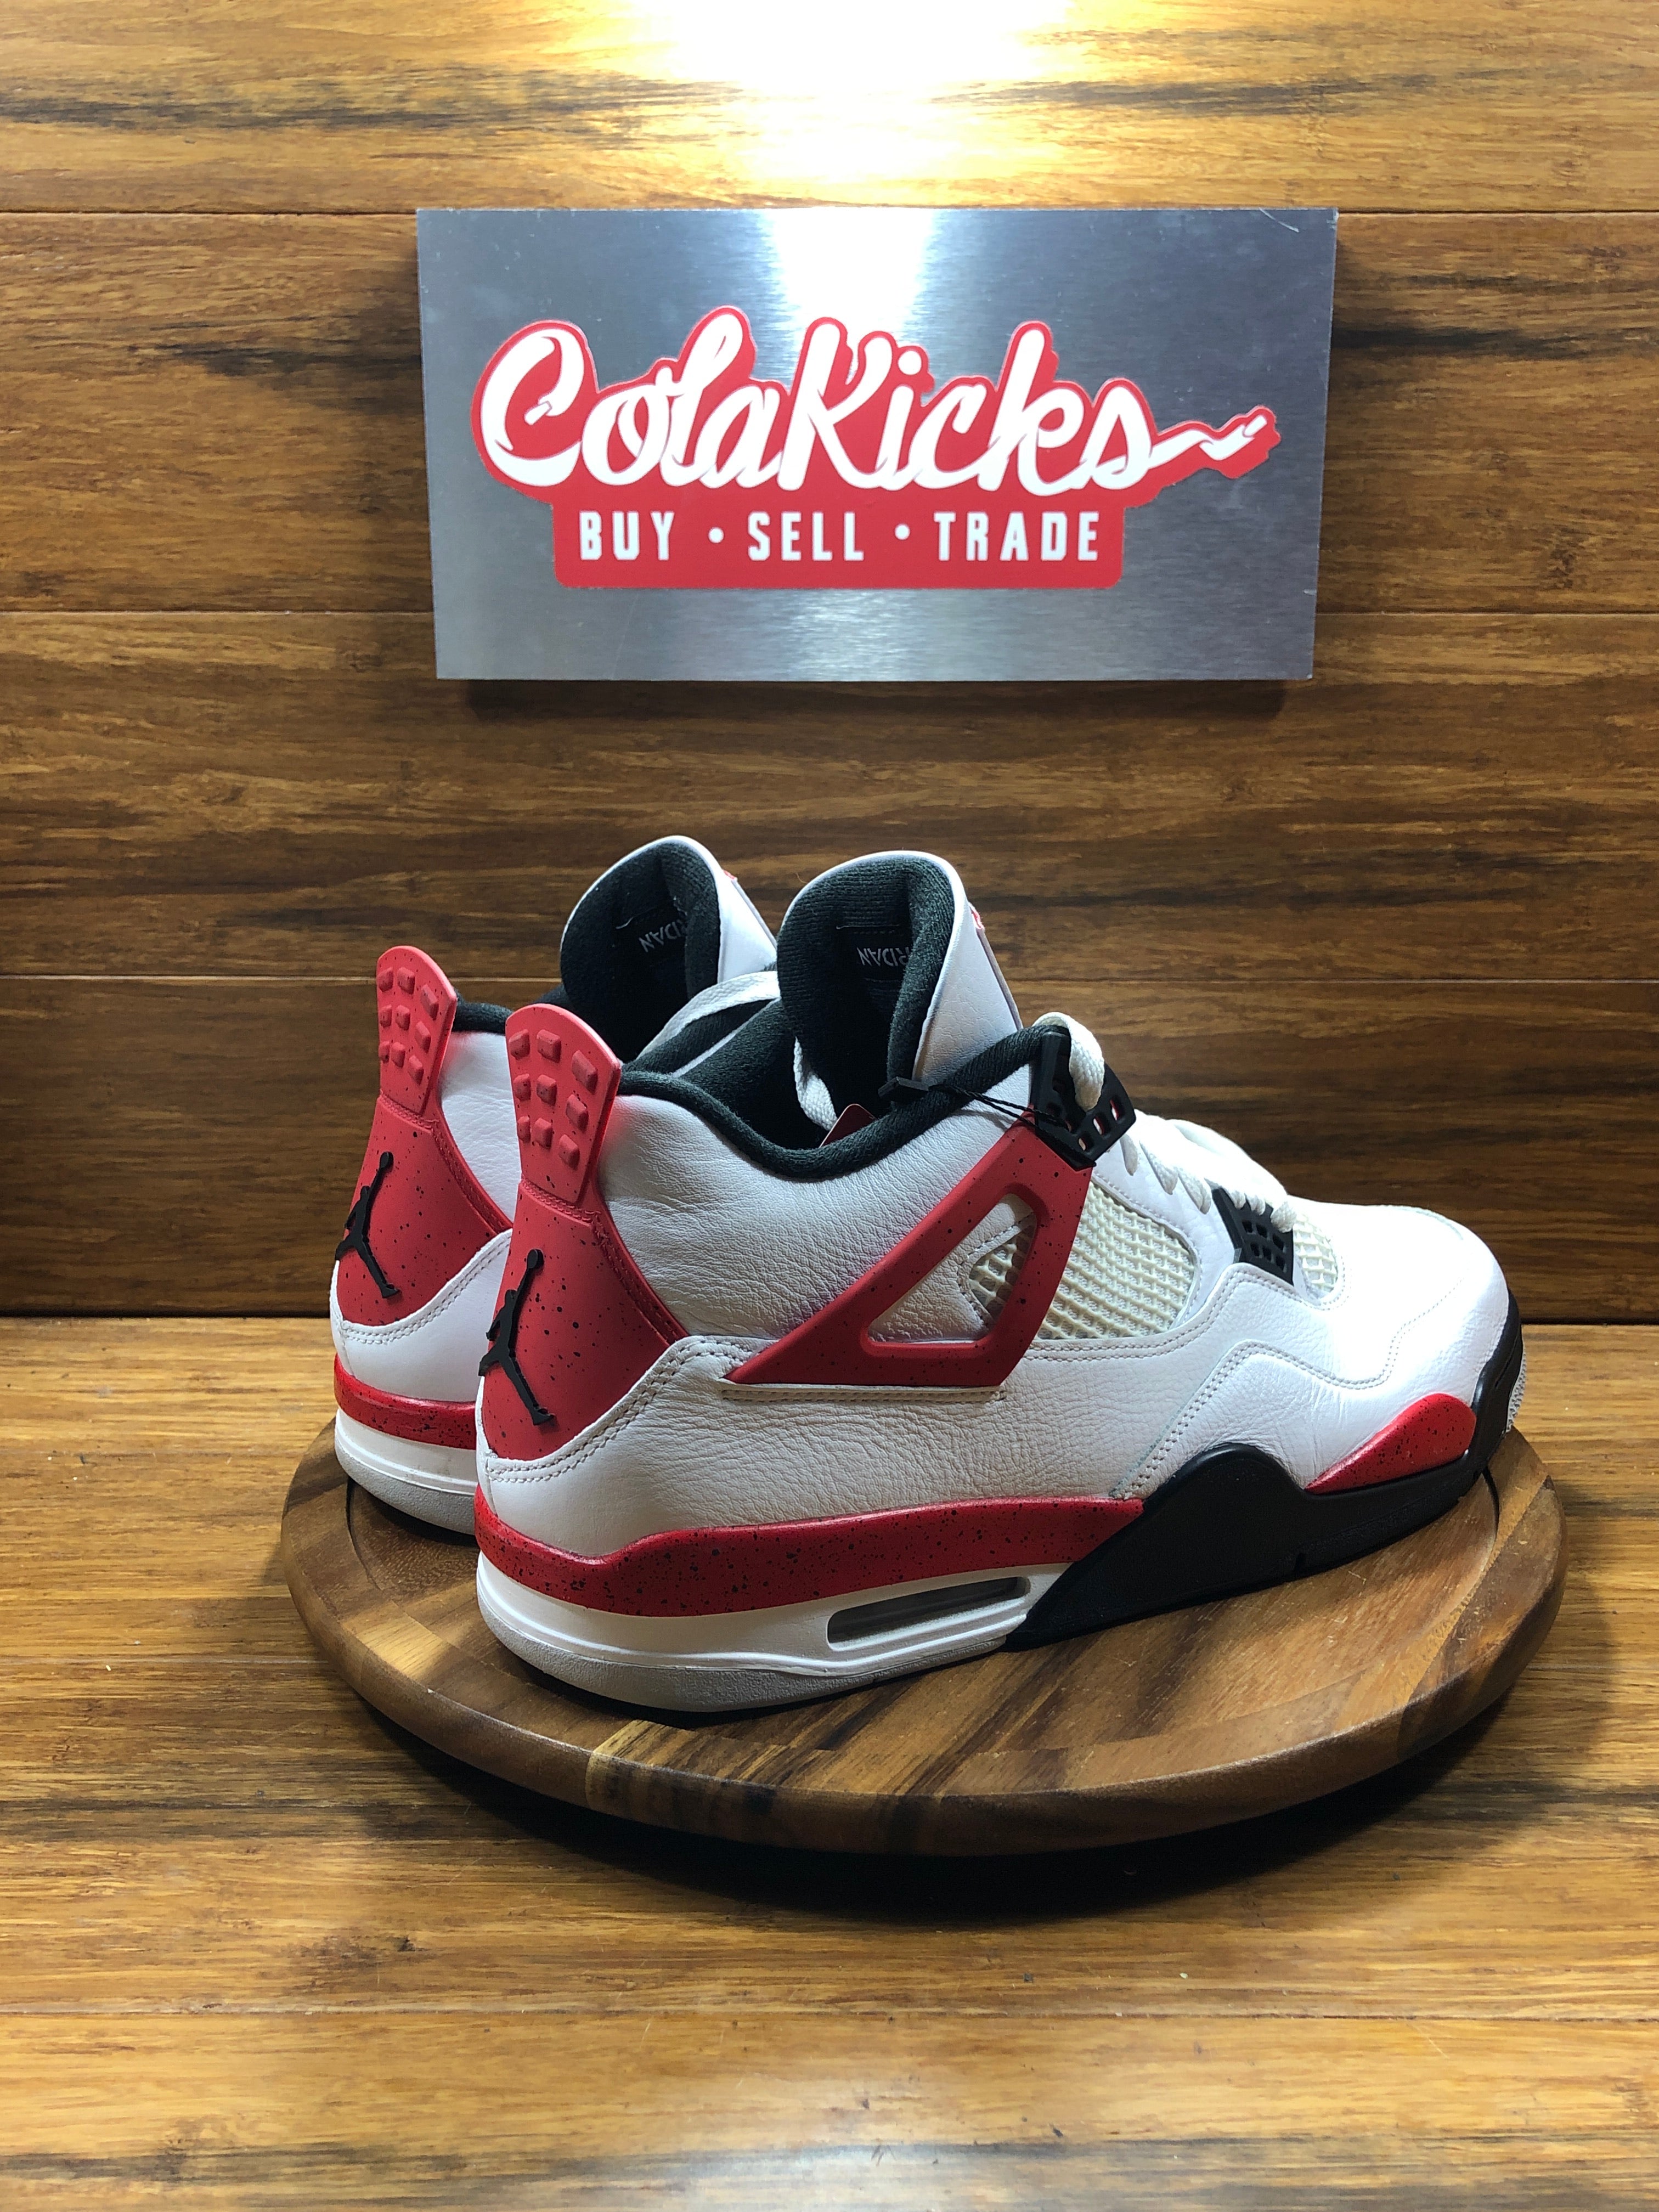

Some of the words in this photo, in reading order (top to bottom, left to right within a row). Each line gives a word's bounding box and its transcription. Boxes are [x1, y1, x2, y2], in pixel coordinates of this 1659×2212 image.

[481, 313, 1267, 496] ColaKicks
[579, 511, 675, 561] BUY
[748, 511, 865, 561] SELL
[934, 511, 1099, 561] TRADE
[856, 946, 911, 967] RDAN
